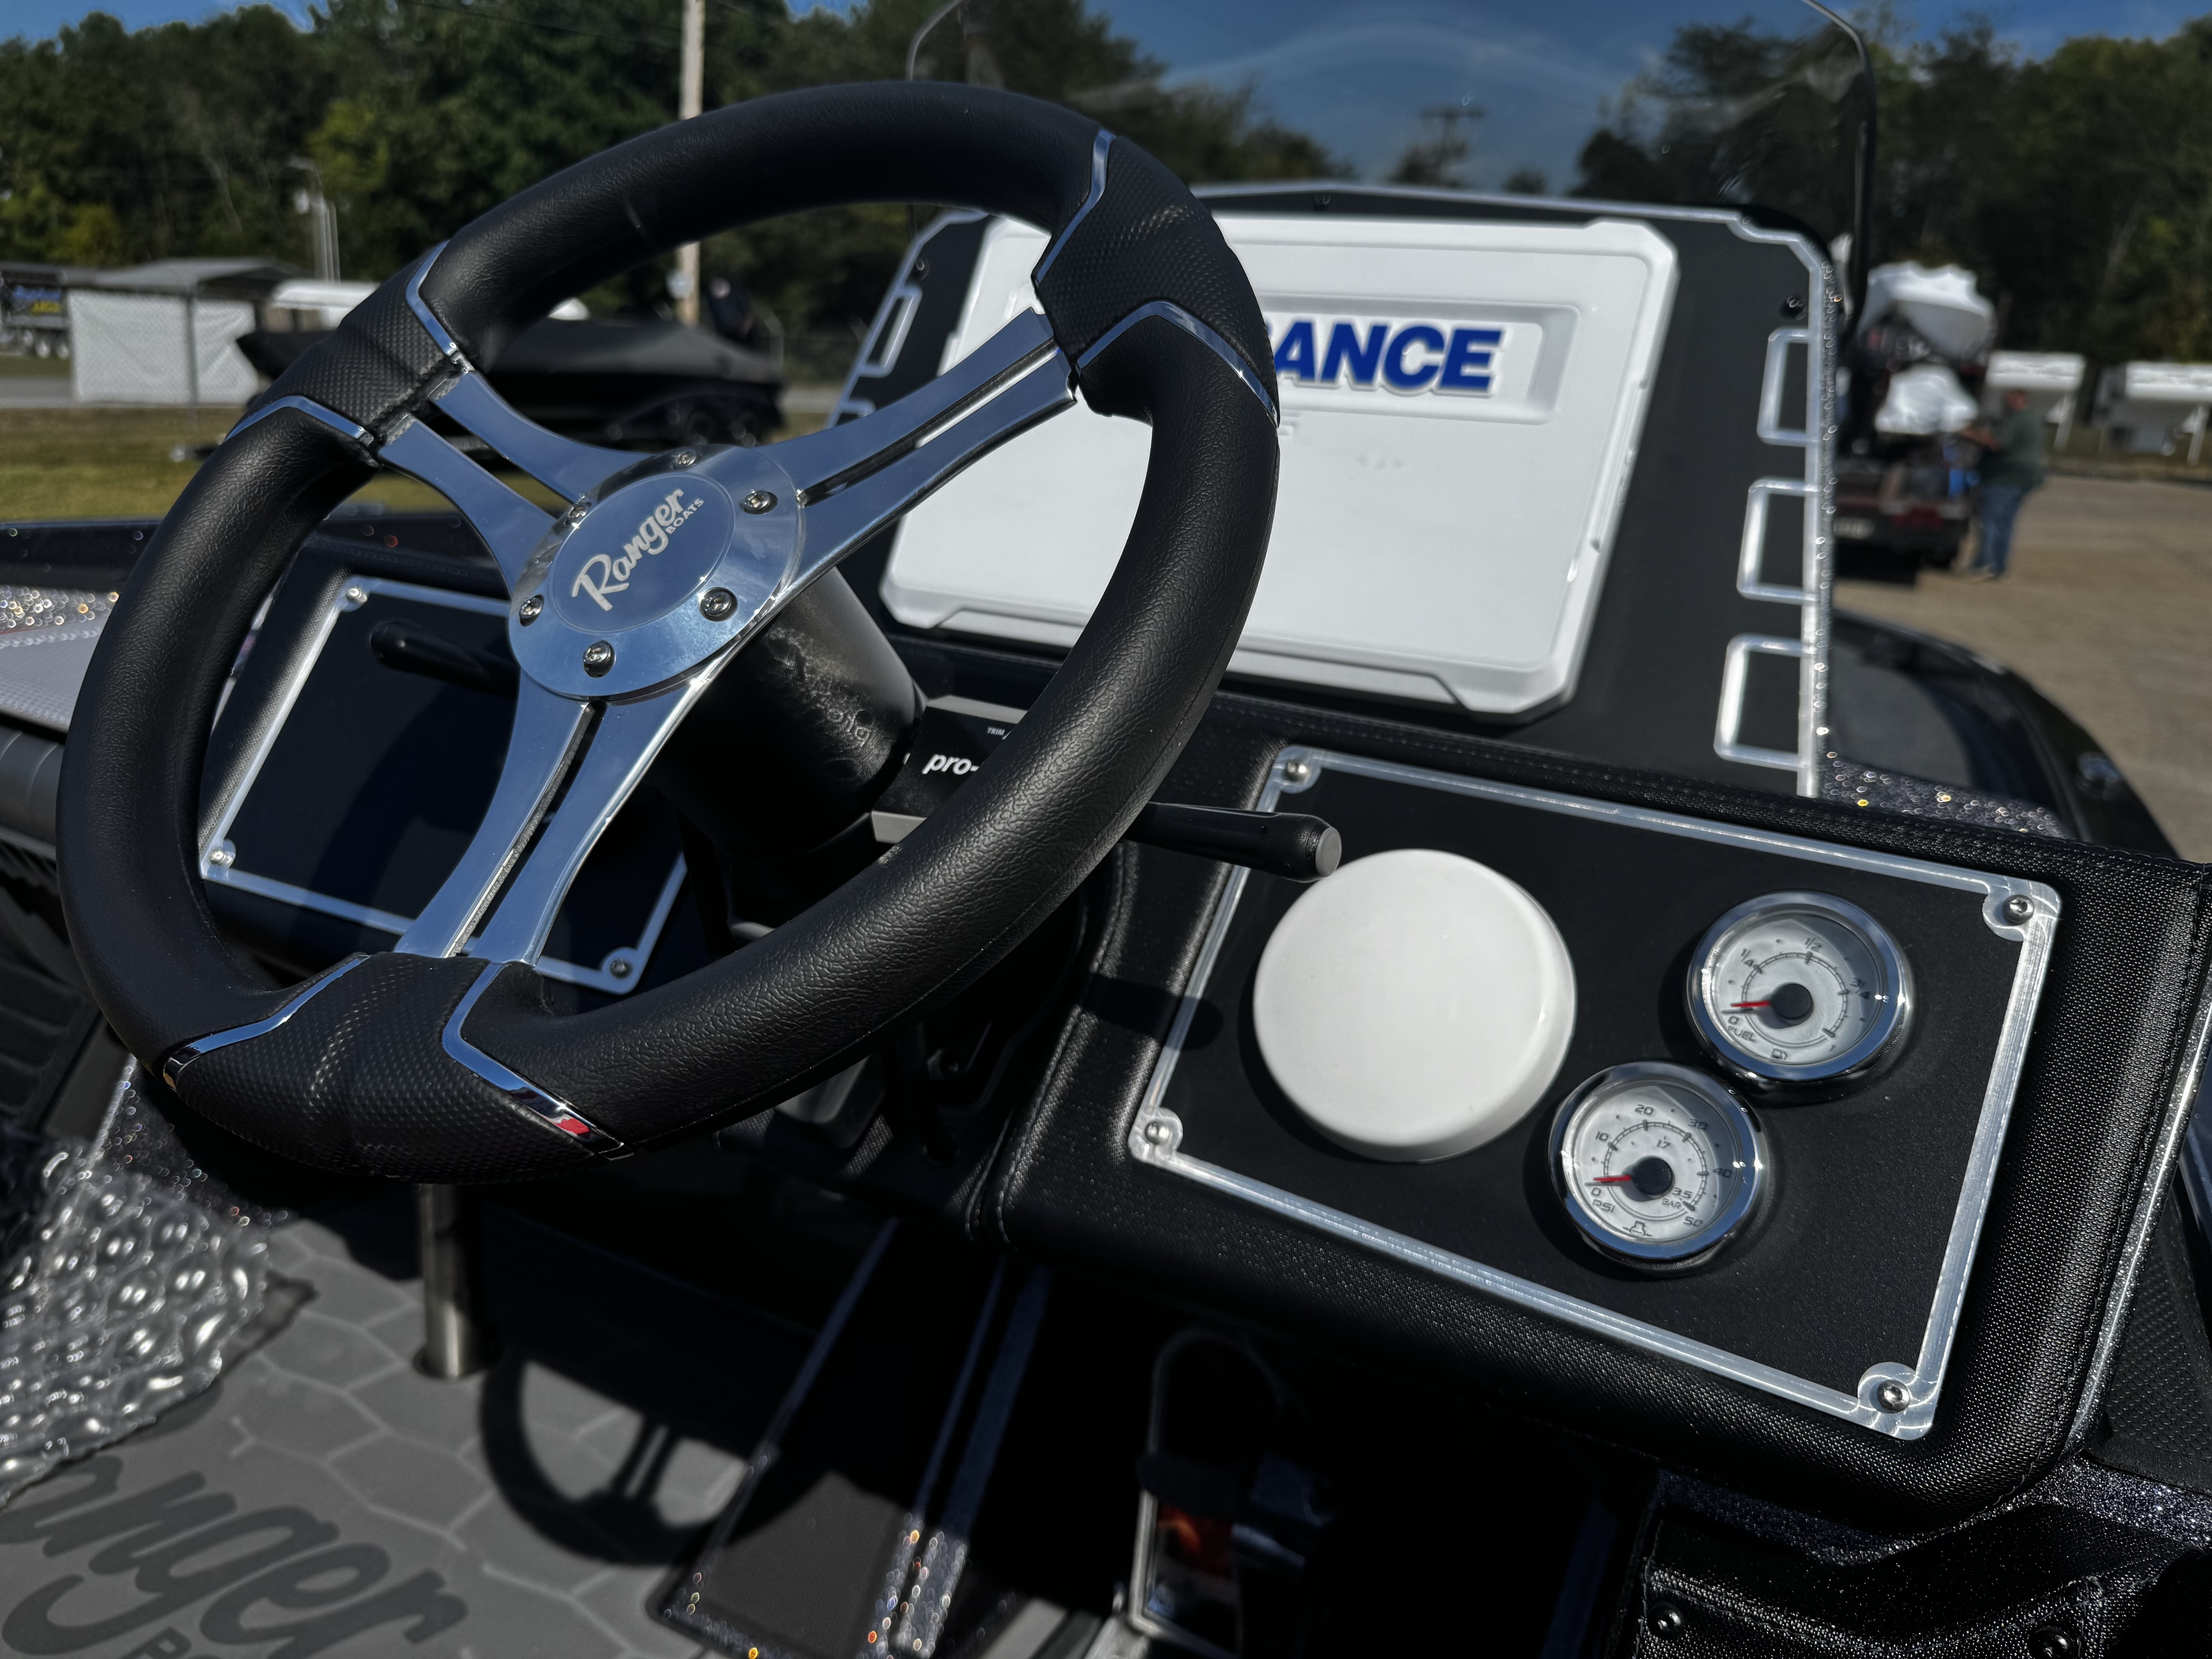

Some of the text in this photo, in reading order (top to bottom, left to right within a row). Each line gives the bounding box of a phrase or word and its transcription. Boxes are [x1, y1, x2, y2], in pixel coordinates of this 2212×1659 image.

[1267, 321, 1503, 390] ANCE
[665, 498, 704, 535] BOATS
[572, 489, 685, 611] Ranger
[987, 726, 1006, 735] TRIM
[1805, 938, 1822, 951] 1/2
[1741, 948, 1754, 967] 1/4
[1728, 1026, 1755, 1042] FUEL
[1635, 1105, 1654, 1115] 20
[1688, 1119, 1708, 1130] 30
[1596, 1132, 1609, 1141] 10
[1713, 1168, 1732, 1178] 40
[1592, 1200, 1615, 1212] PSI
[1662, 1199, 1681, 1209] BAR
[1683, 1216, 1703, 1226] 50
